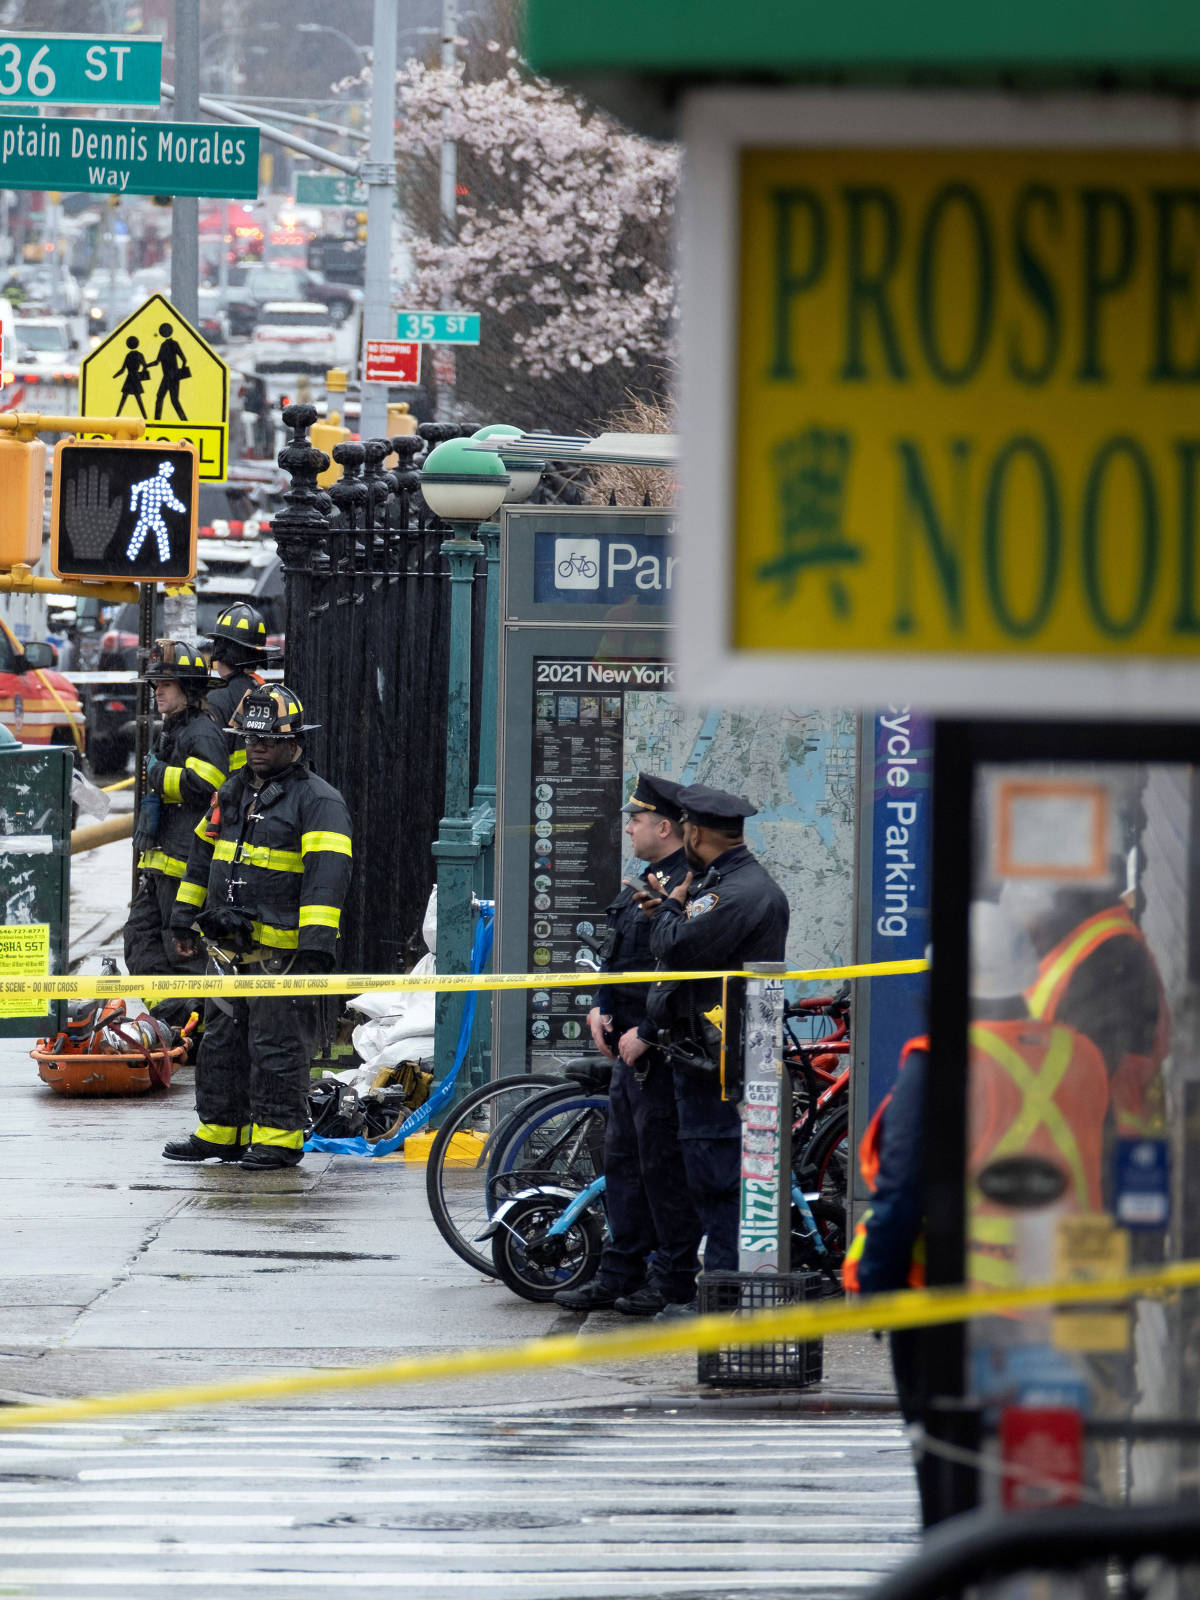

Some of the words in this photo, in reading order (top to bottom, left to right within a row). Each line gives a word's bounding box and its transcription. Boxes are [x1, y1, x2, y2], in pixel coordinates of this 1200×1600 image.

[84, 45, 131, 81] ST
[71, 127, 148, 161] Dennis
[157, 131, 246, 165] Morales
[88, 166, 130, 191] Way
[406, 315, 435, 339] 35
[446, 317, 468, 333] ST
[537, 665, 582, 683] 2021
[587, 665, 631, 684] New
[631, 666, 677, 684] York
[248, 707, 271, 719] 279
[877, 801, 917, 937] Parking
[24, 942, 45, 952] SST
[5, 982, 26, 992] SCENE
[32, 982, 42, 992] DO
[43, 982, 56, 992] NOT
[57, 982, 78, 992] CROSS
[115, 983, 145, 993] stoppers
[151, 980, 202, 991] 1-800-577-TIPS
[202, 979, 223, 991] (8477)
[234, 979, 255, 989] CRIME
[255, 979, 276, 989] SCENE
[283, 979, 293, 989] DO
[294, 979, 307, 988] NOT
[307, 978, 329, 988] CROSS
[365, 979, 396, 988] stoppers
[749, 1093, 774, 1102] GAK
